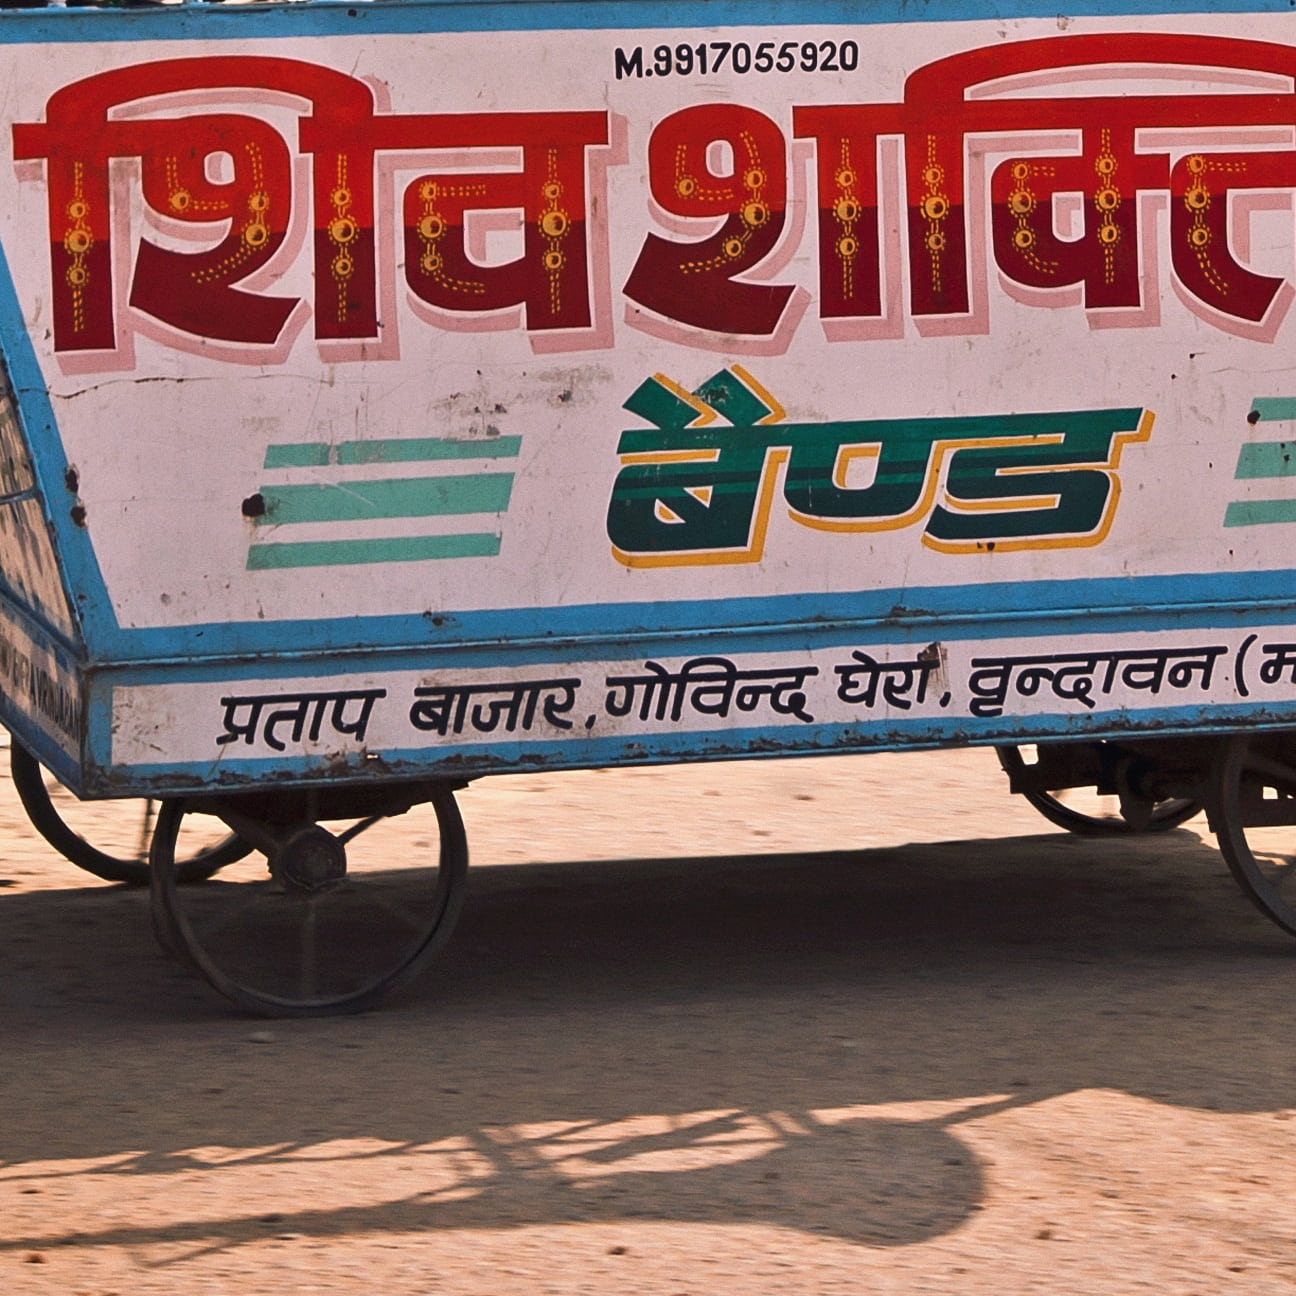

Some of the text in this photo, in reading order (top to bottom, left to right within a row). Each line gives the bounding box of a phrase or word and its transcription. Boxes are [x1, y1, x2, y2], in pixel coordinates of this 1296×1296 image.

[614, 40, 859, 80] M.9917055920
[12, 54, 610, 354] शिव
[607, 364, 1155, 568] बैण्ड
[216, 688, 387, 752] प्रताप
[606, 657, 814, 723] गोविन्द
[968, 645, 1228, 717] वृन्दावन
